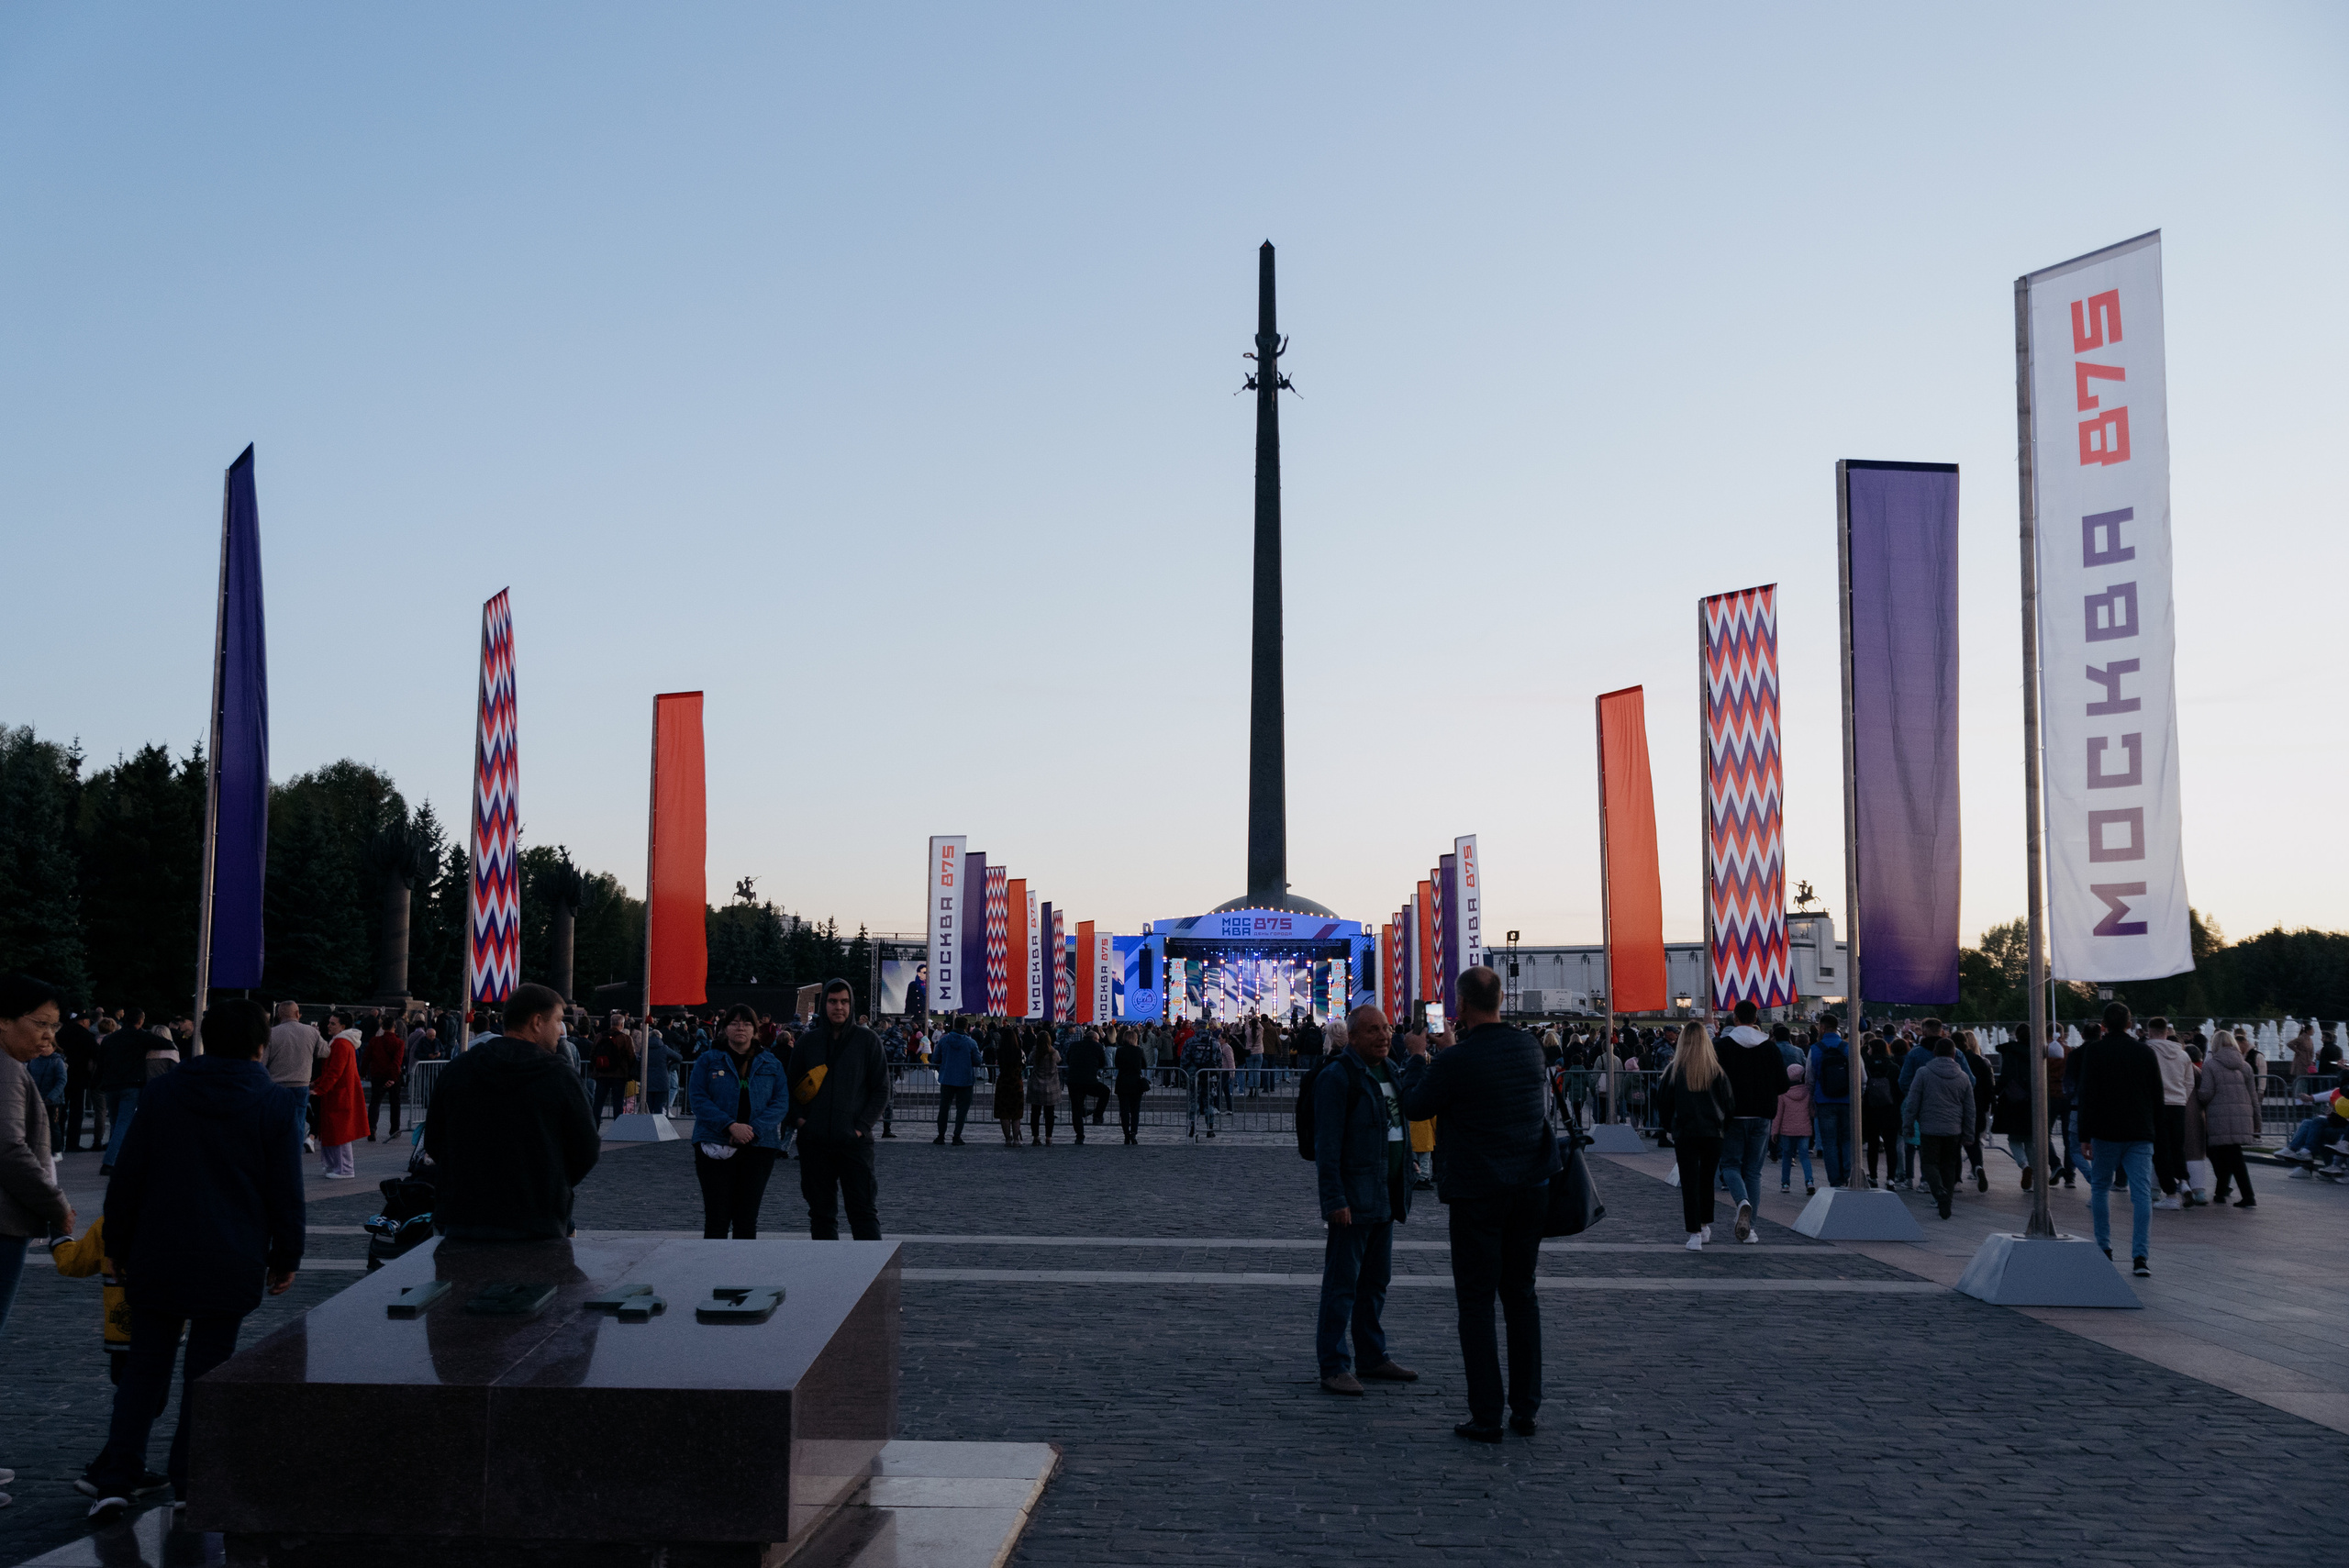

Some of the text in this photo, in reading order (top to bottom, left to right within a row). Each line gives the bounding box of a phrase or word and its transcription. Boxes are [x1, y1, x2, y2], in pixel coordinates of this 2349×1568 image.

[2071, 288, 2148, 937] МОСКВА 875
[940, 845, 954, 999] МОСКВА 875
[1029, 897, 1041, 1011] МОСКВА 875
[1222, 917, 1251, 926] МОС
[1222, 928, 1251, 936] КВА
[1254, 918, 1292, 929] 875
[1464, 845, 1479, 967] СКВА 875
